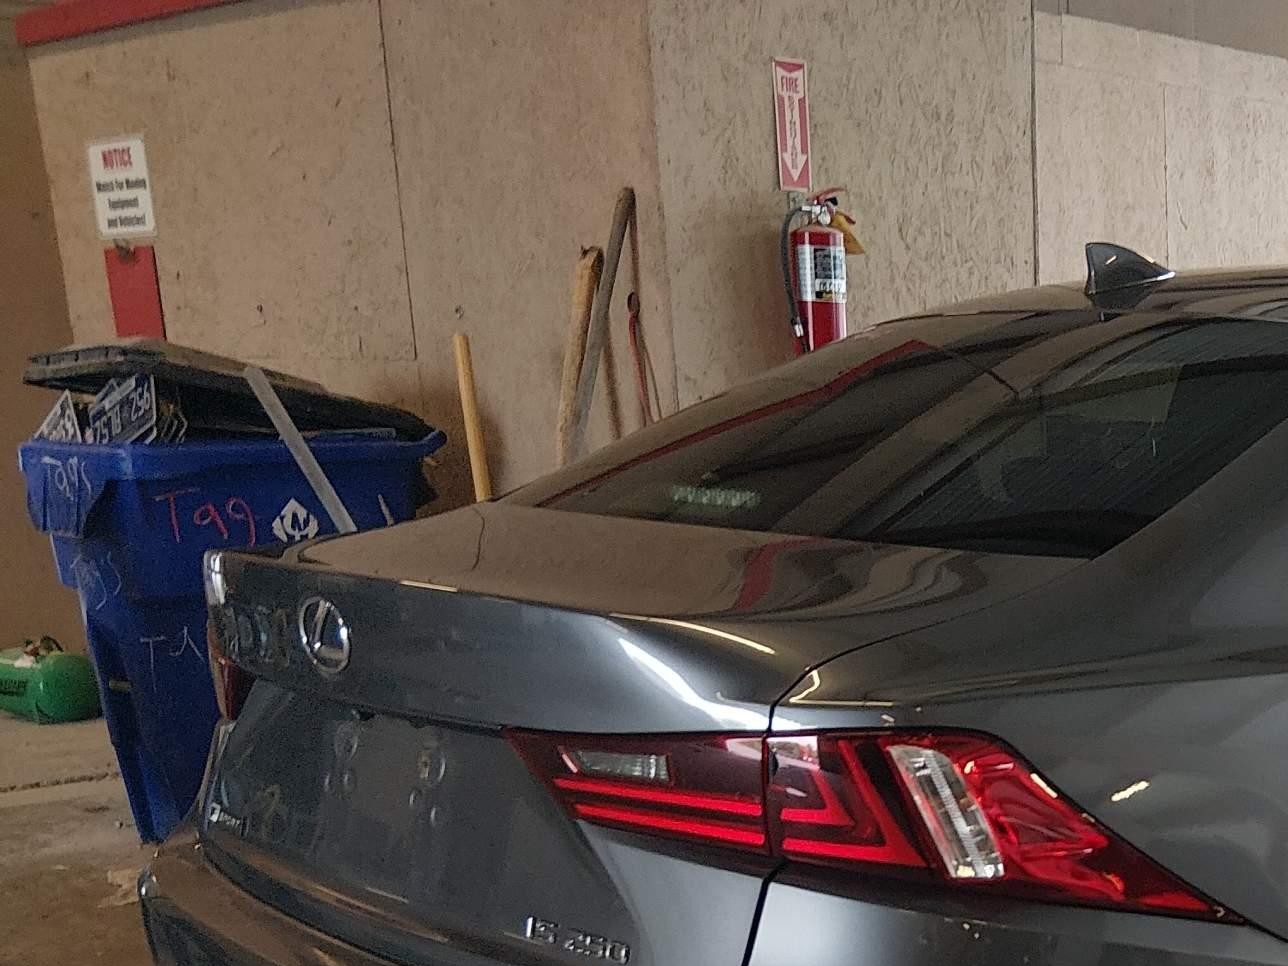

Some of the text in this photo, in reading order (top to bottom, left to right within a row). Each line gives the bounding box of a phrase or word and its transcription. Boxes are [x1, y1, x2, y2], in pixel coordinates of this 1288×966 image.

[780, 75, 800, 94] FIRE
[101, 147, 133, 169] NOTICE
[564, 929, 631, 965] 250
